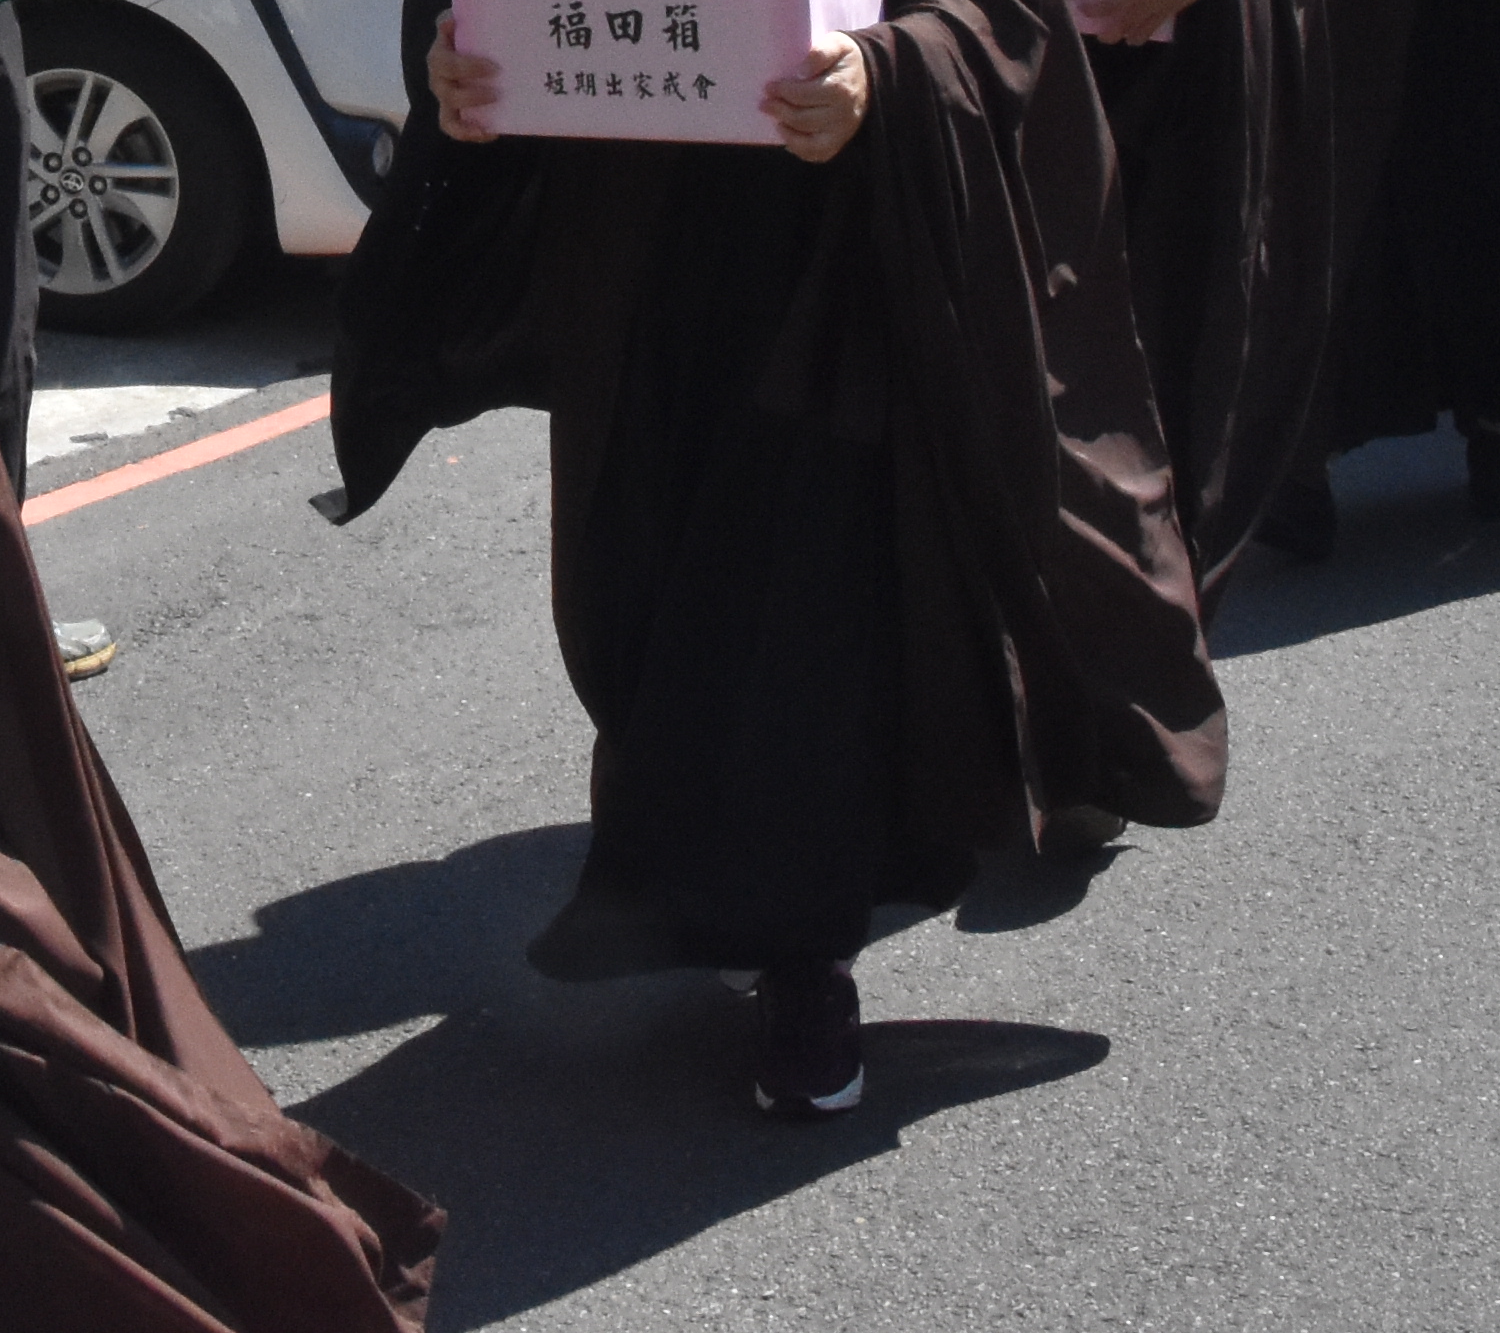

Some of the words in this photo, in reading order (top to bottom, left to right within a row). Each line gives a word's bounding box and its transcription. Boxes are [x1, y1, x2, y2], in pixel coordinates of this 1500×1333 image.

[546, 2, 702, 53] 福田箱
[543, 71, 718, 102] 短期出家戒會
